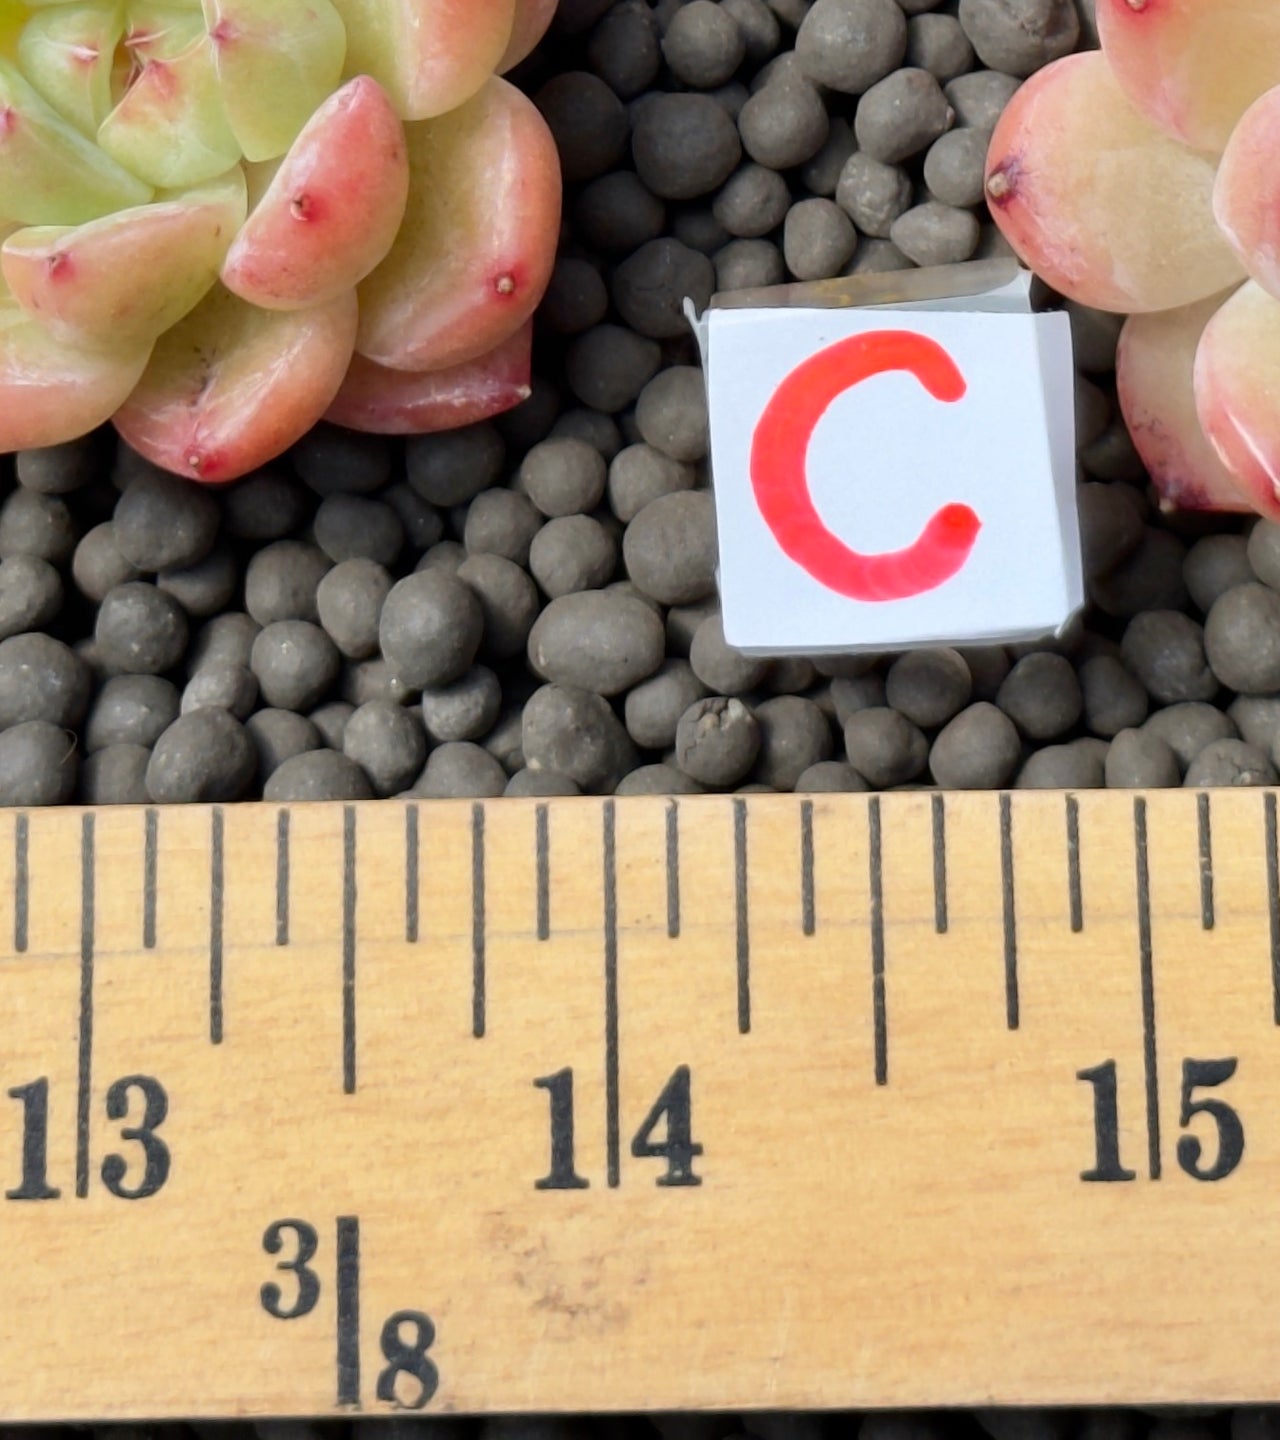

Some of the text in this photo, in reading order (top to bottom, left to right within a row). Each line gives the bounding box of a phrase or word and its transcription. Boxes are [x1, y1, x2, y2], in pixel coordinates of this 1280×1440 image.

[751, 331, 980, 601] C
[6, 1075, 172, 1200] 13
[533, 1065, 704, 1190] 14
[1077, 1058, 1246, 1182] 15
